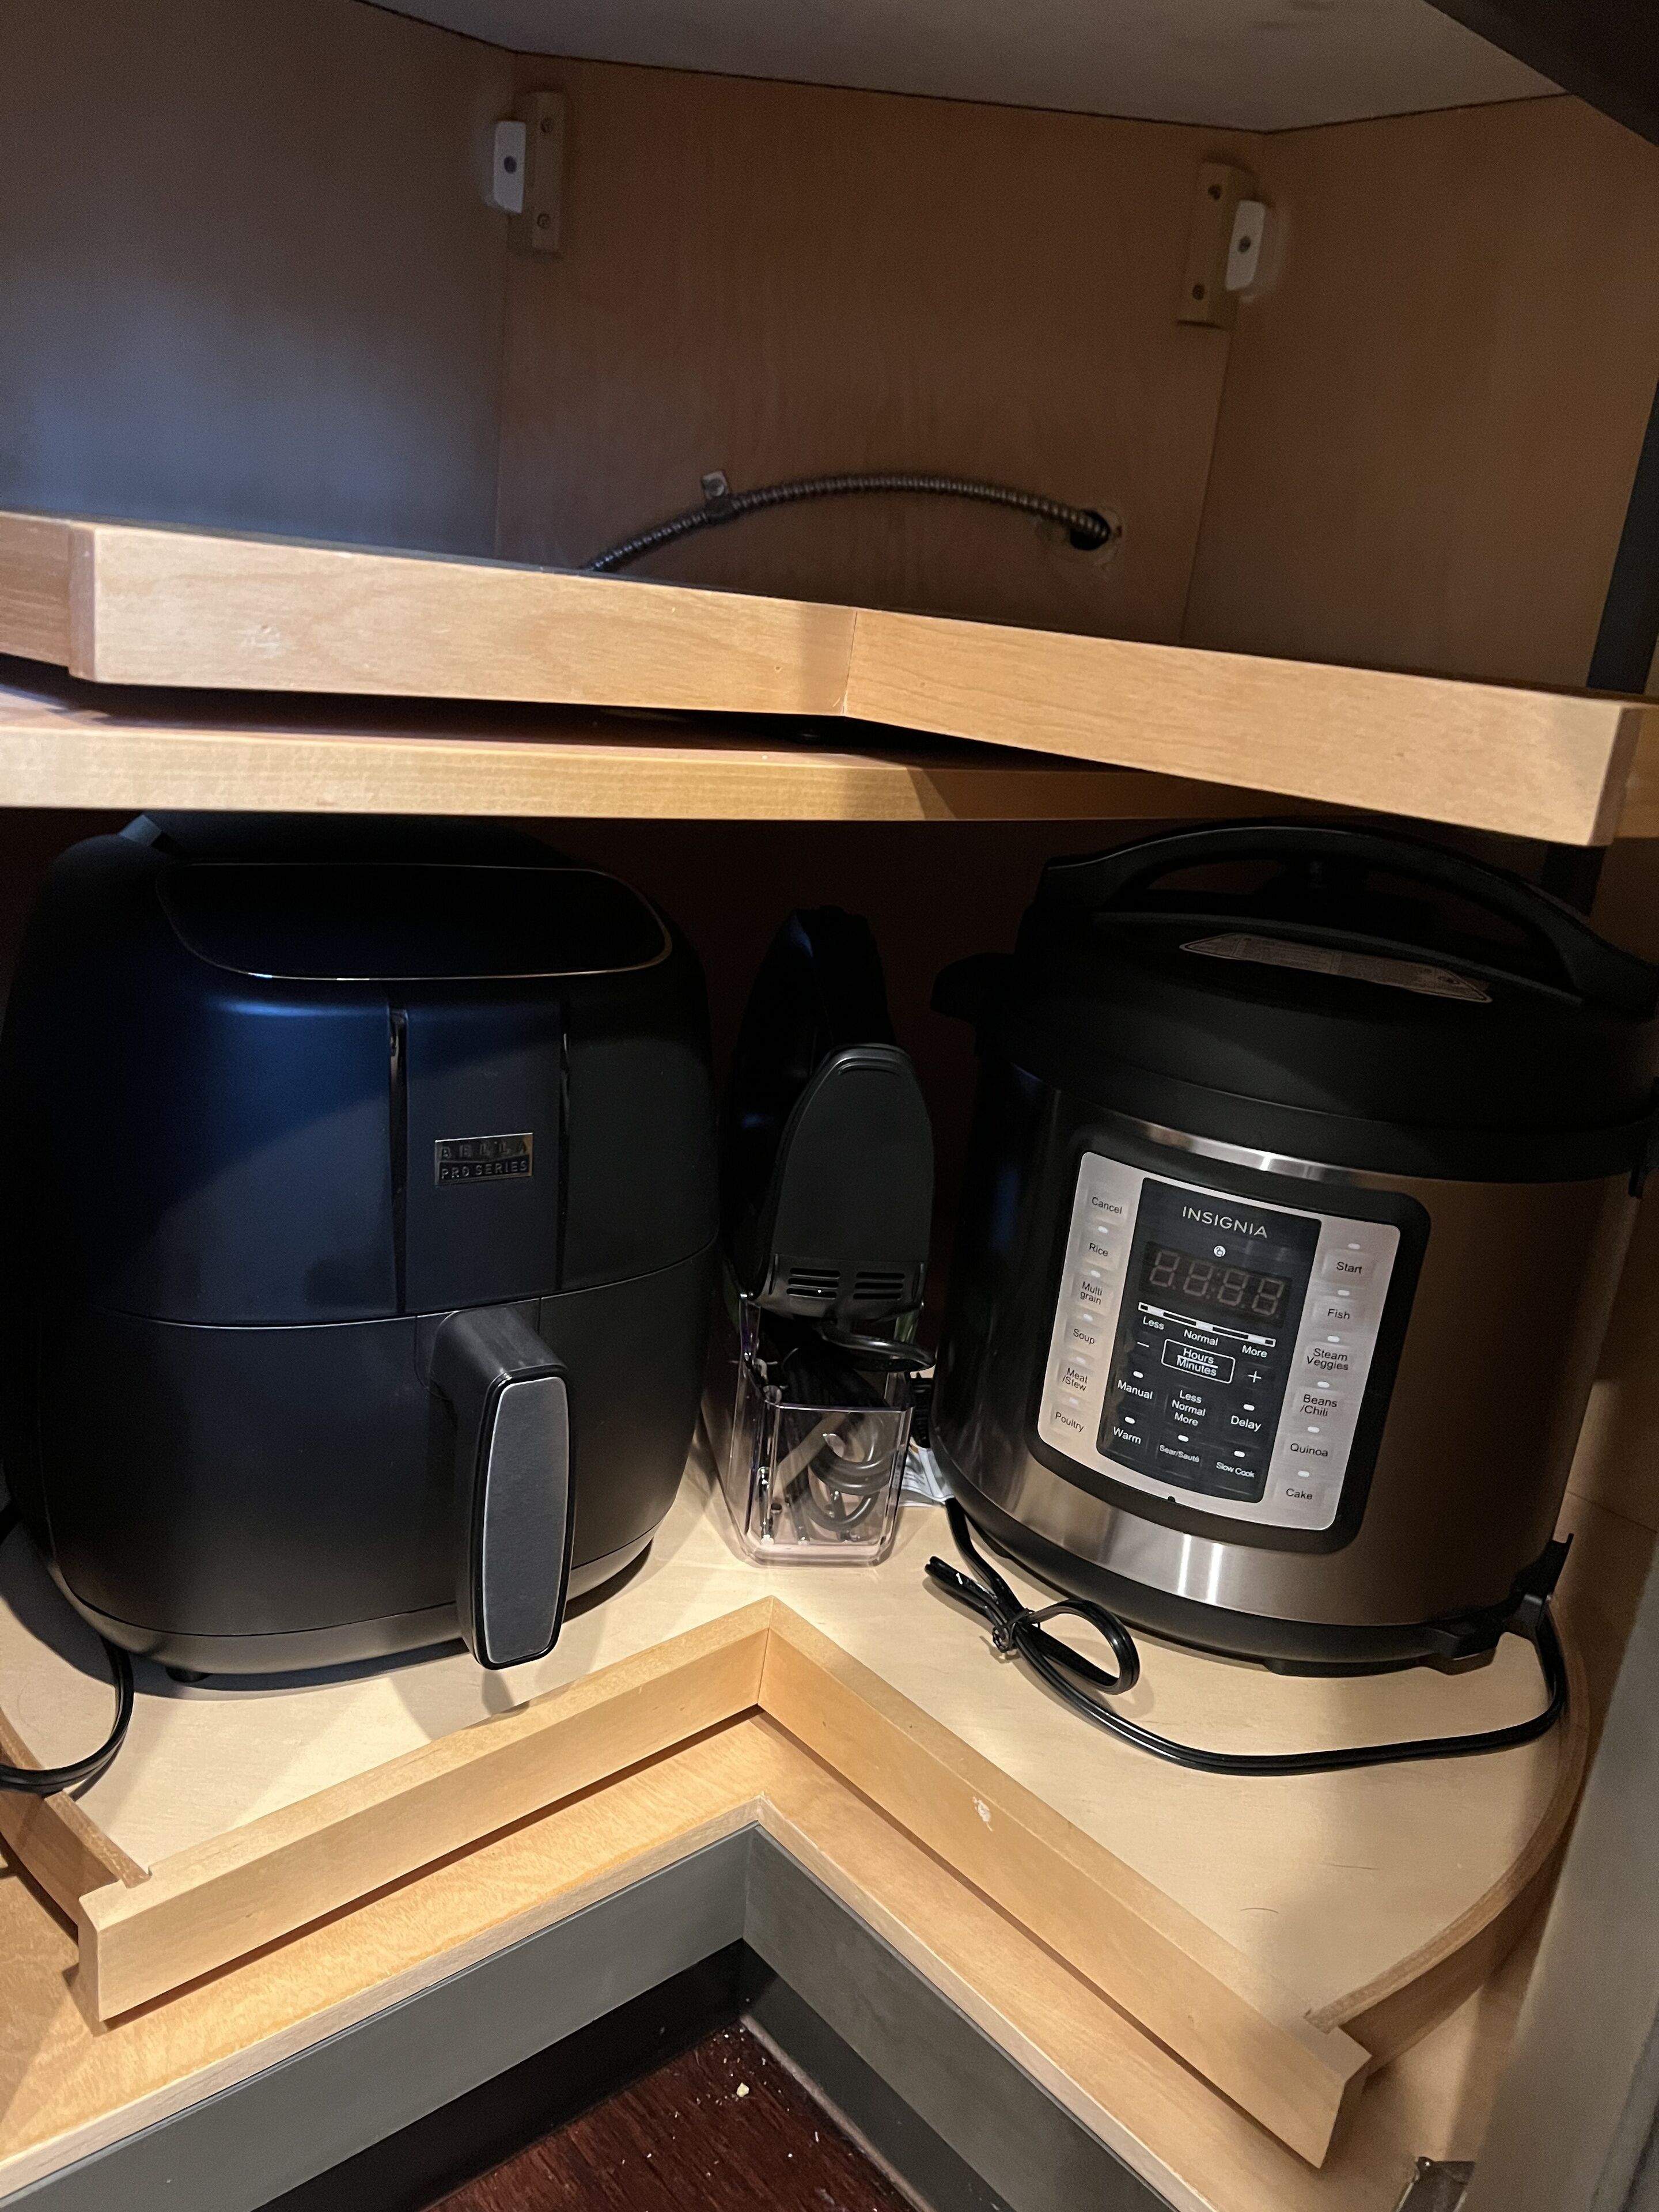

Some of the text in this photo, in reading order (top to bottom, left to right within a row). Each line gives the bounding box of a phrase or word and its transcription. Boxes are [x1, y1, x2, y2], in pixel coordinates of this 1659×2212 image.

[441, 1160, 528, 1179] PRO SERIES
[1092, 1196, 1122, 1214] Cancel
[1183, 1206, 1267, 1238] INSIGNIA
[1089, 1243, 1108, 1256] Rice
[1336, 1262, 1362, 1274] Start
[1082, 1281, 1103, 1296] Multi
[1080, 1291, 1101, 1305] grain
[1327, 1308, 1350, 1320] Fish
[1073, 1328, 1094, 1344] Soup
[1142, 1316, 1267, 1358] Less Normal More
[1183, 1348, 1214, 1364] Hours
[1313, 1348, 1347, 1361] Steam
[1176, 1356, 1217, 1376] Minutes
[1307, 1356, 1349, 1370] Veggies
[1067, 1368, 1088, 1384] Meat
[1118, 1380, 1153, 1399] Manual
[1180, 1390, 1202, 1403] Less
[1172, 1400, 1206, 1416] Normal
[1303, 1394, 1338, 1407] Beans
[1055, 1411, 1084, 1432] Poultry
[1175, 1412, 1198, 1426] More
[1230, 1415, 1261, 1432] Delay
[1113, 1426, 1141, 1444] Warm
[1290, 1443, 1328, 1457] Quinoa
[1216, 1461, 1255, 1478] Slow Cook
[1286, 1488, 1313, 1500] Cake
